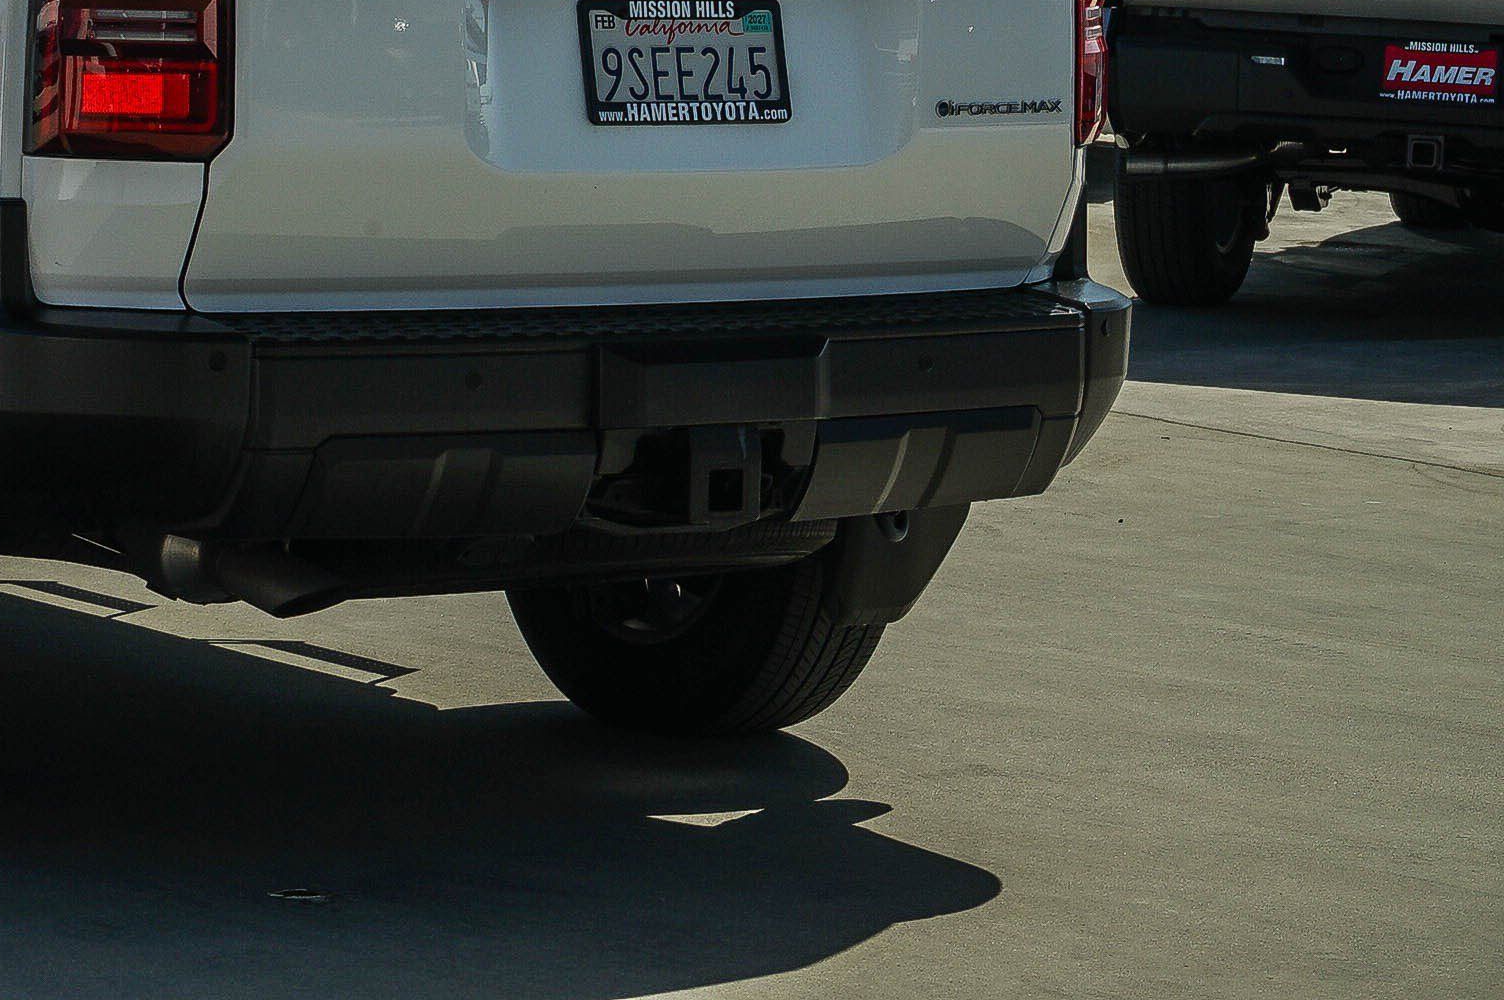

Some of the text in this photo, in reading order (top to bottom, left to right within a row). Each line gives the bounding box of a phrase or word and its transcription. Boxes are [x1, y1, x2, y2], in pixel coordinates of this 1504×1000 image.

[629, 0, 735, 19] MISSION HILLS
[594, 14, 616, 30] FEB
[748, 14, 767, 25] 2027
[625, 18, 744, 45] California
[1409, 41, 1475, 54] MISSION HILLS
[601, 46, 773, 101] 9SEE245
[1386, 59, 1496, 86] HAMER
